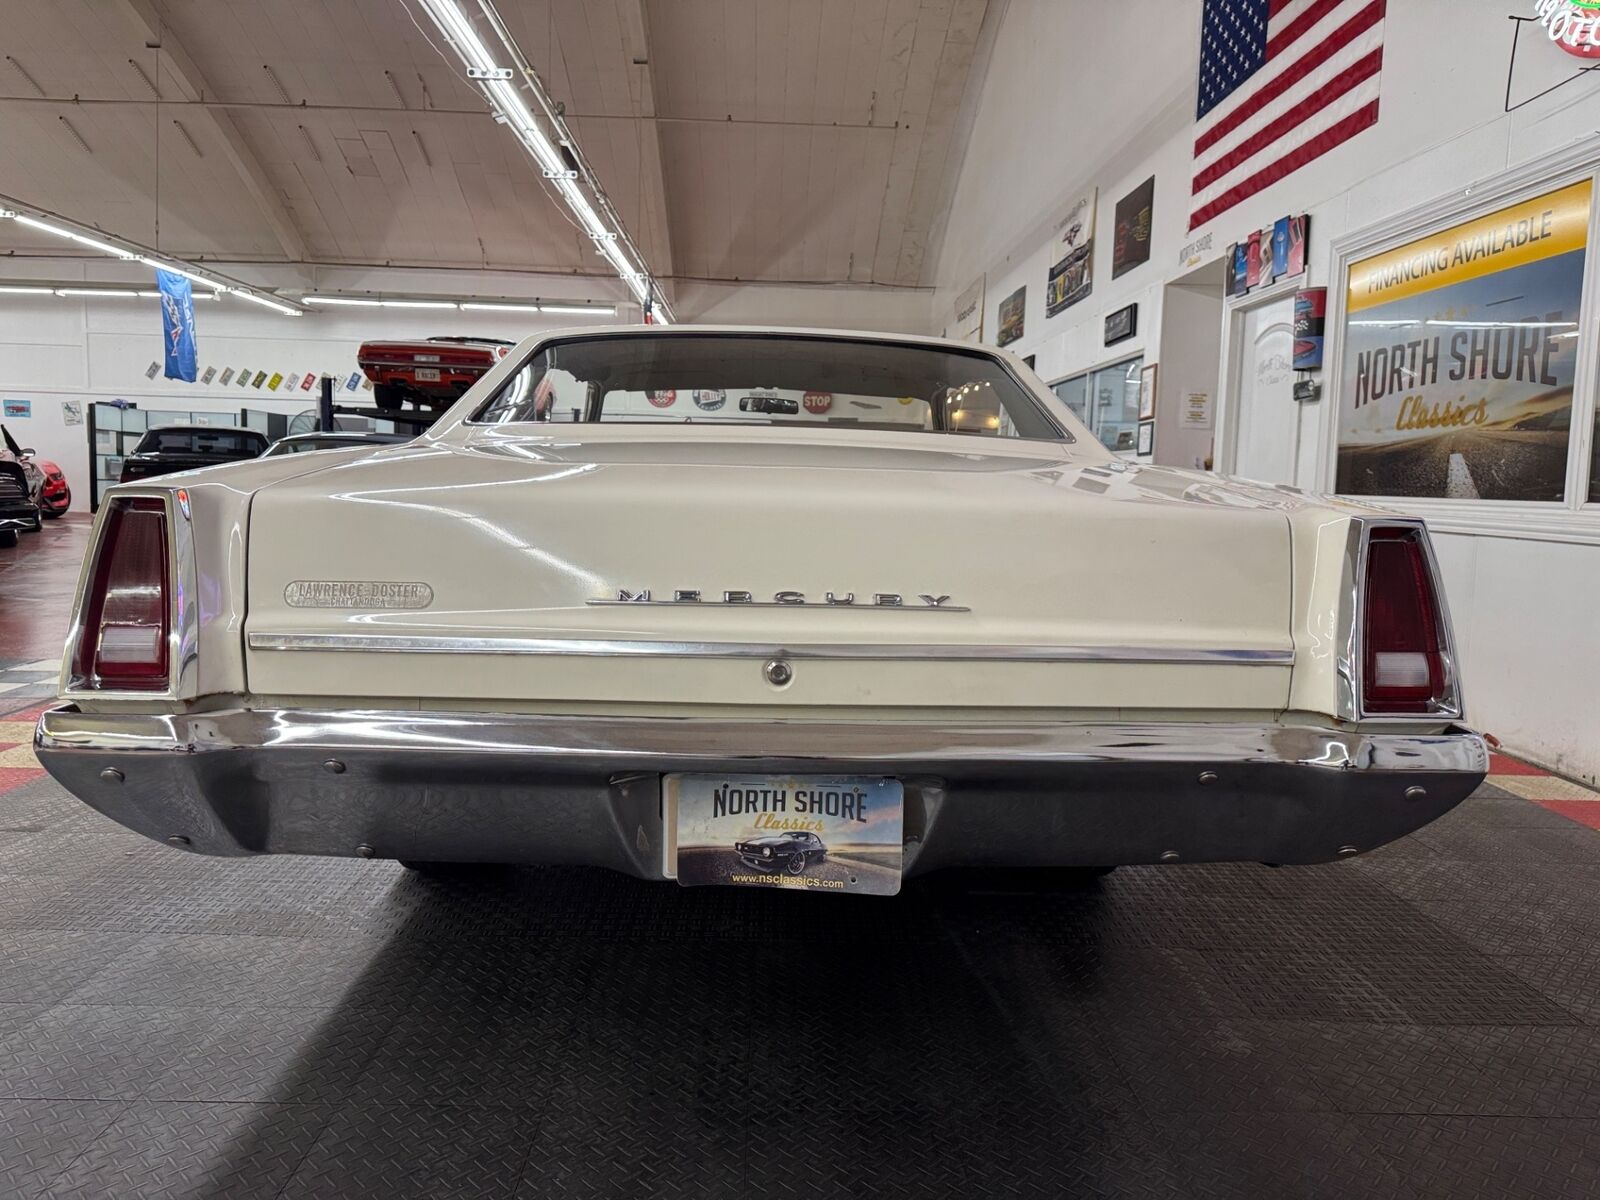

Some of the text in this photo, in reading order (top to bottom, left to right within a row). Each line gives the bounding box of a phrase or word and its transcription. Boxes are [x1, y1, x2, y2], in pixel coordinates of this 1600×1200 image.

[1368, 210, 1552, 294] FINANCING AVAILABLE
[1355, 311, 1562, 409] NORTH SHORE
[804, 394, 831, 407] STOP
[1395, 395, 1490, 431] Classics
[299, 583, 418, 598] LAWRENCE DOSTER
[617, 589, 951, 607] MERCURY
[713, 788, 868, 823] NORTH SHORE
[753, 813, 824, 832] Classics
[731, 873, 844, 889] www.nsclassics.com
